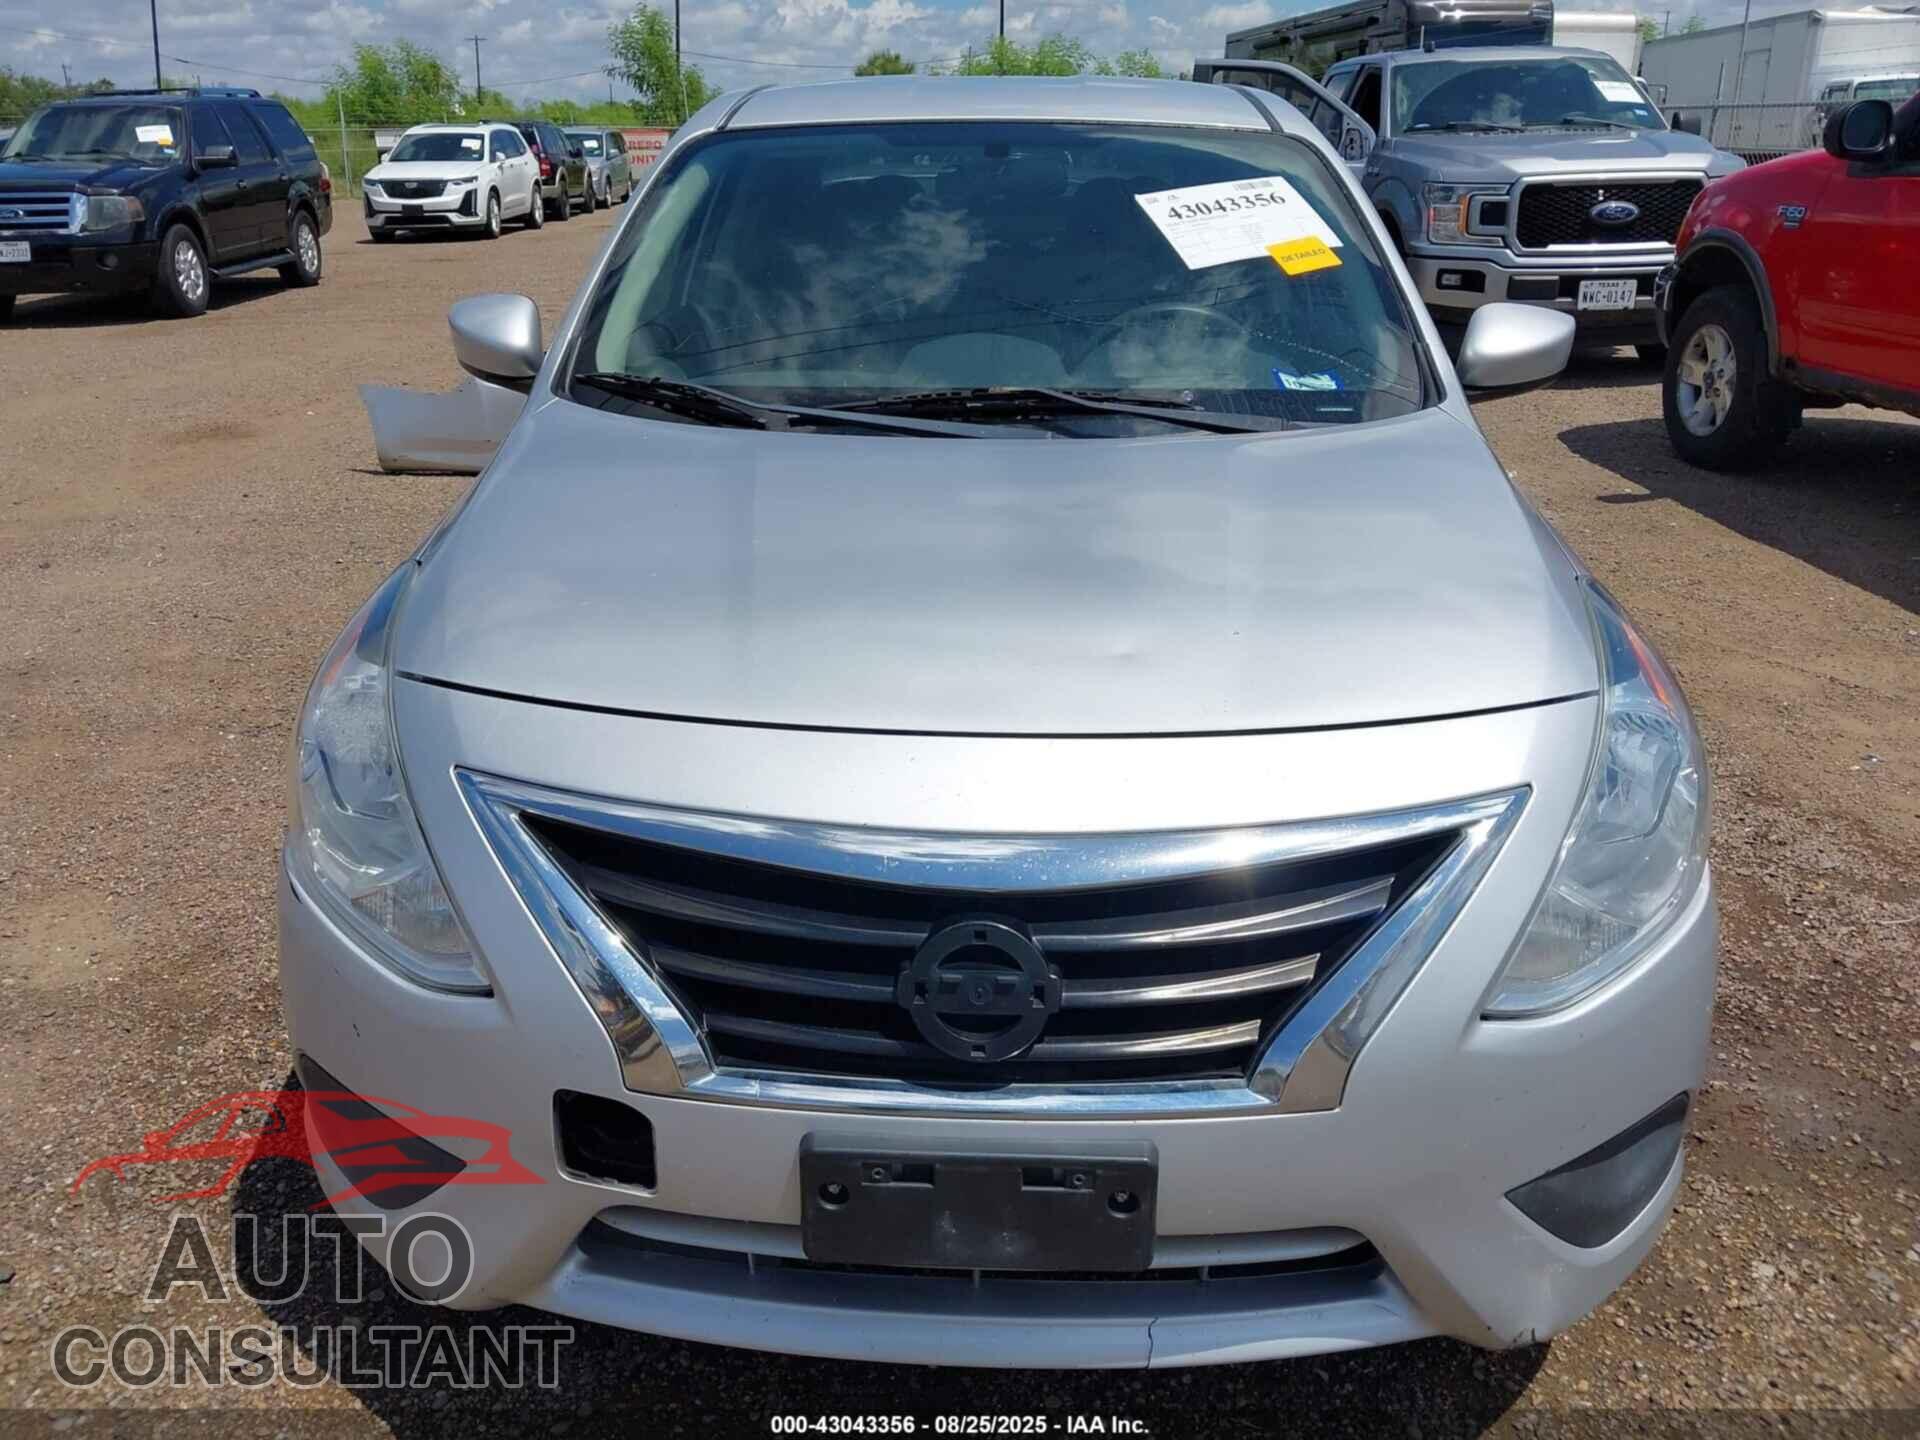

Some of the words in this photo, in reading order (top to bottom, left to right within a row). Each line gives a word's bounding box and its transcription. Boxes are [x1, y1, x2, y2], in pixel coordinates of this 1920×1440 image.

[628, 140, 662, 150] REPO
[1168, 191, 1286, 220] 43043356
[1281, 248, 1326, 264] DETAILED
